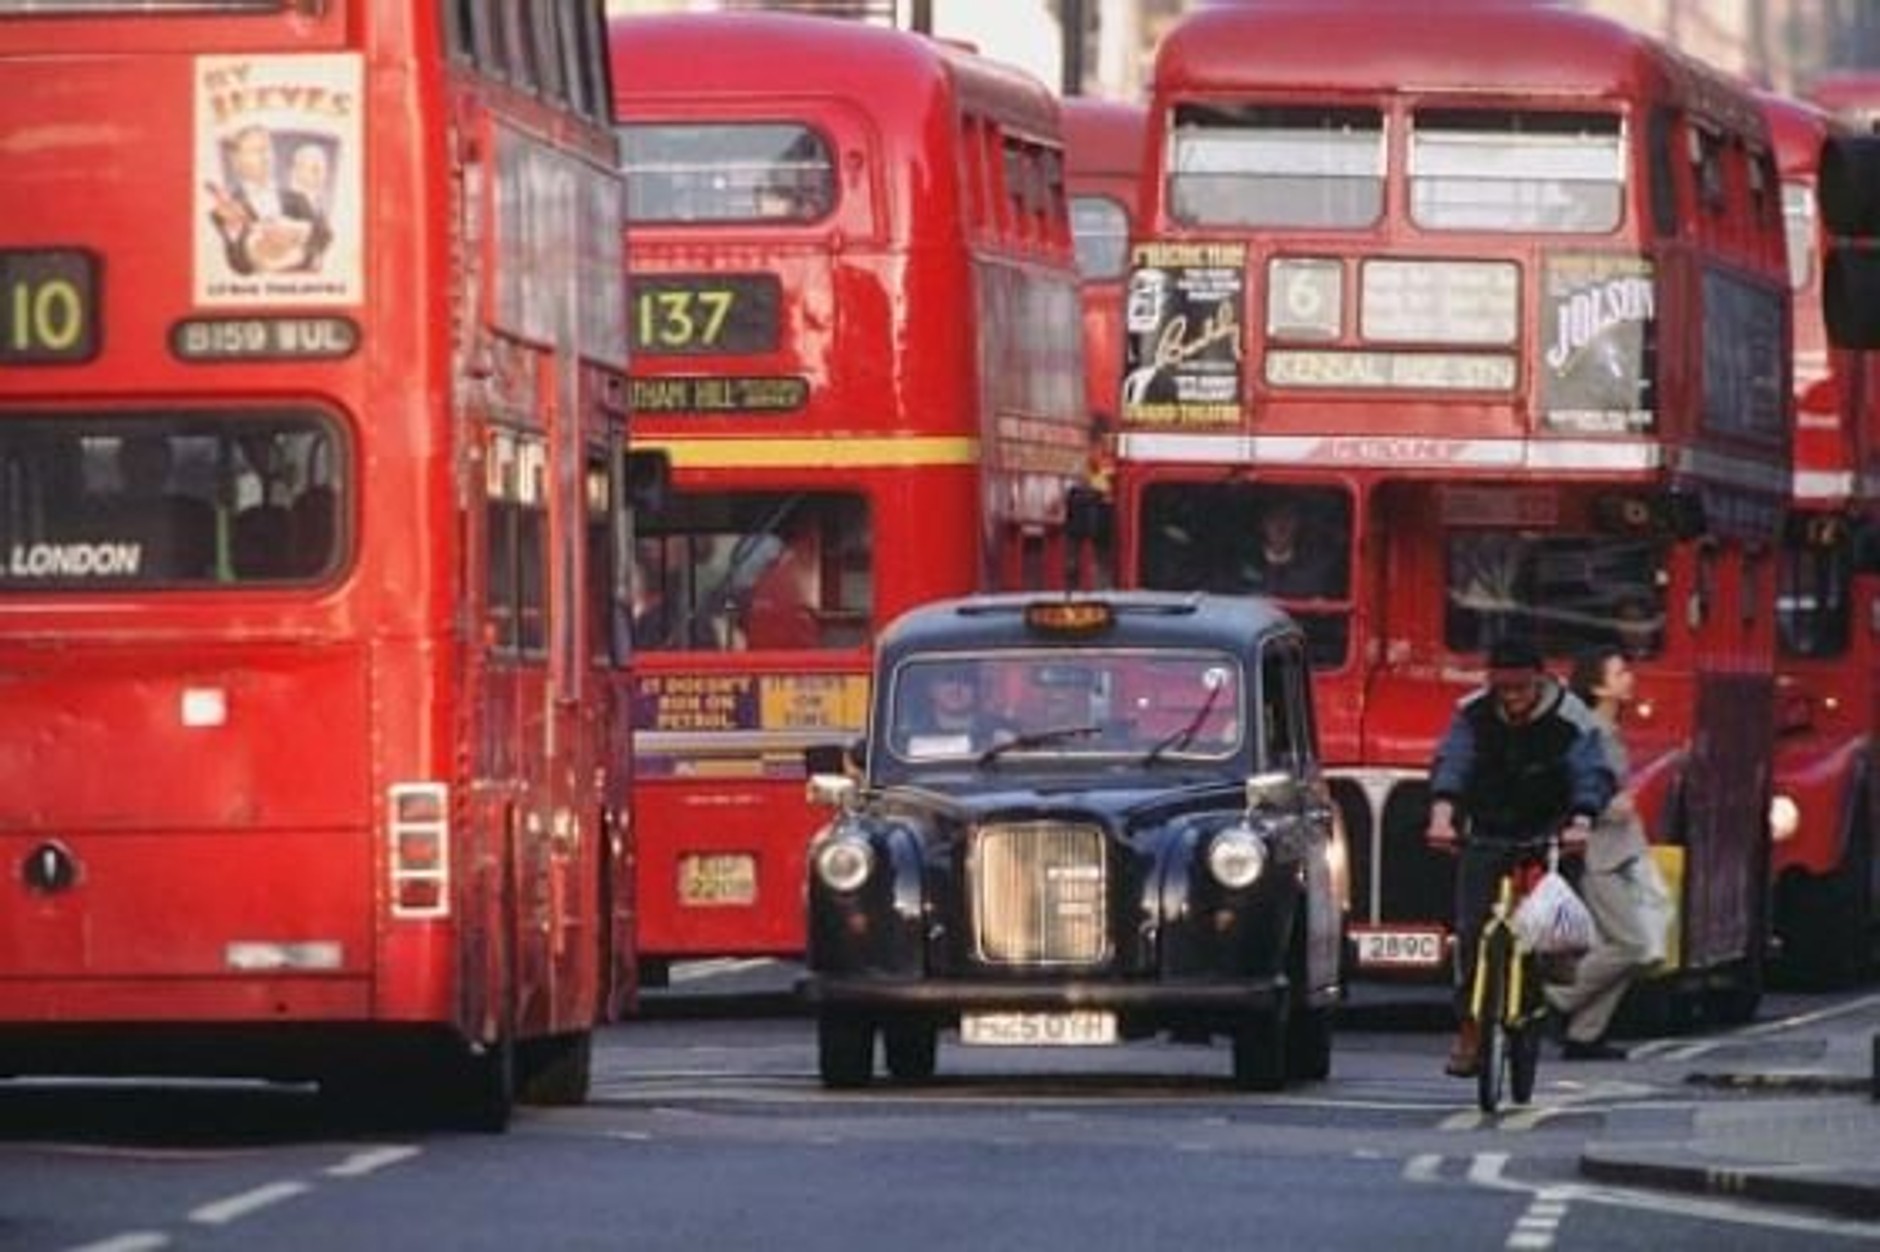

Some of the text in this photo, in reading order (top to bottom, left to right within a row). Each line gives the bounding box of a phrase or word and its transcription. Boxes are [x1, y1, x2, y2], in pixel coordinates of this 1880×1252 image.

[13, 279, 81, 350] 10
[640, 290, 733, 346] 137
[1288, 270, 1321, 317] 6
[1547, 276, 1653, 368] JOLSON
[10, 543, 141, 576] LONDON
